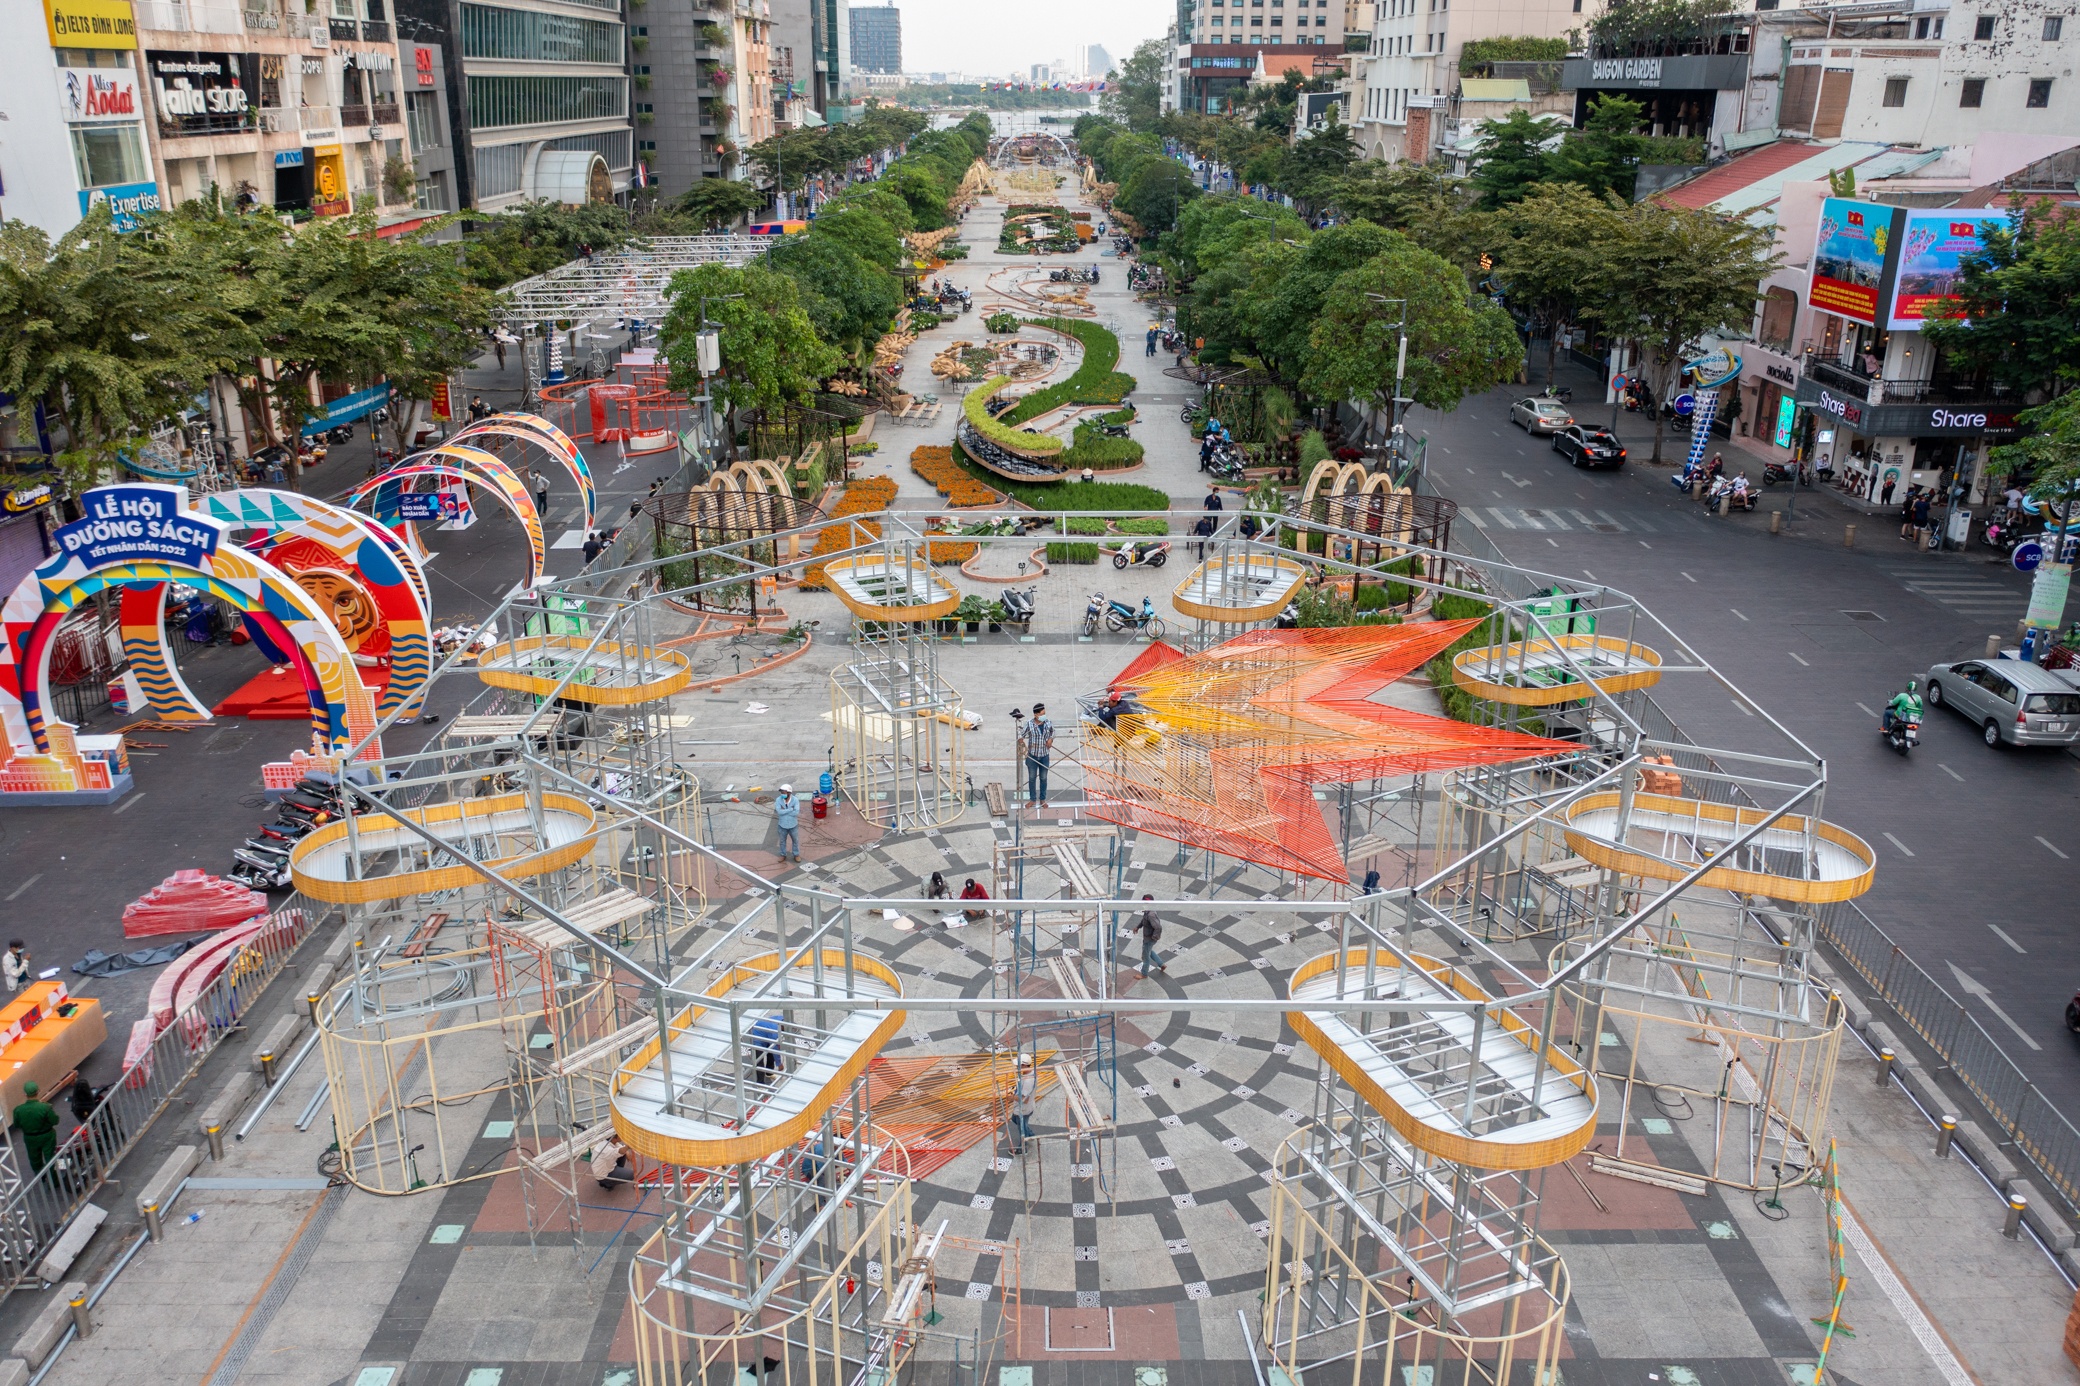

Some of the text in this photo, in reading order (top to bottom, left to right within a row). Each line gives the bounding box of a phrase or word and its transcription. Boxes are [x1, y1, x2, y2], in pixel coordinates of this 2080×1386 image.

[66, 14, 134, 35] IELTS ĐÌNH LONG
[157, 60, 187, 72] furniture
[1592, 59, 1662, 80] SAIGON GARDEN
[94, 74, 113, 91] Miss
[206, 85, 249, 114] store
[109, 192, 160, 218] Expertise
[1766, 364, 1795, 385] sociolla
[1820, 390, 1862, 424] Sharetea
[1930, 408, 2019, 428] Sharetea
[95, 494, 162, 520] LỄ HỘI
[63, 519, 209, 552] ĐƯỜNG SÁCH
[89, 546, 108, 559] TẾT
[107, 541, 137, 555] NHÂM
[159, 544, 187, 557] 2022
[2025, 554, 2042, 562] SCB
